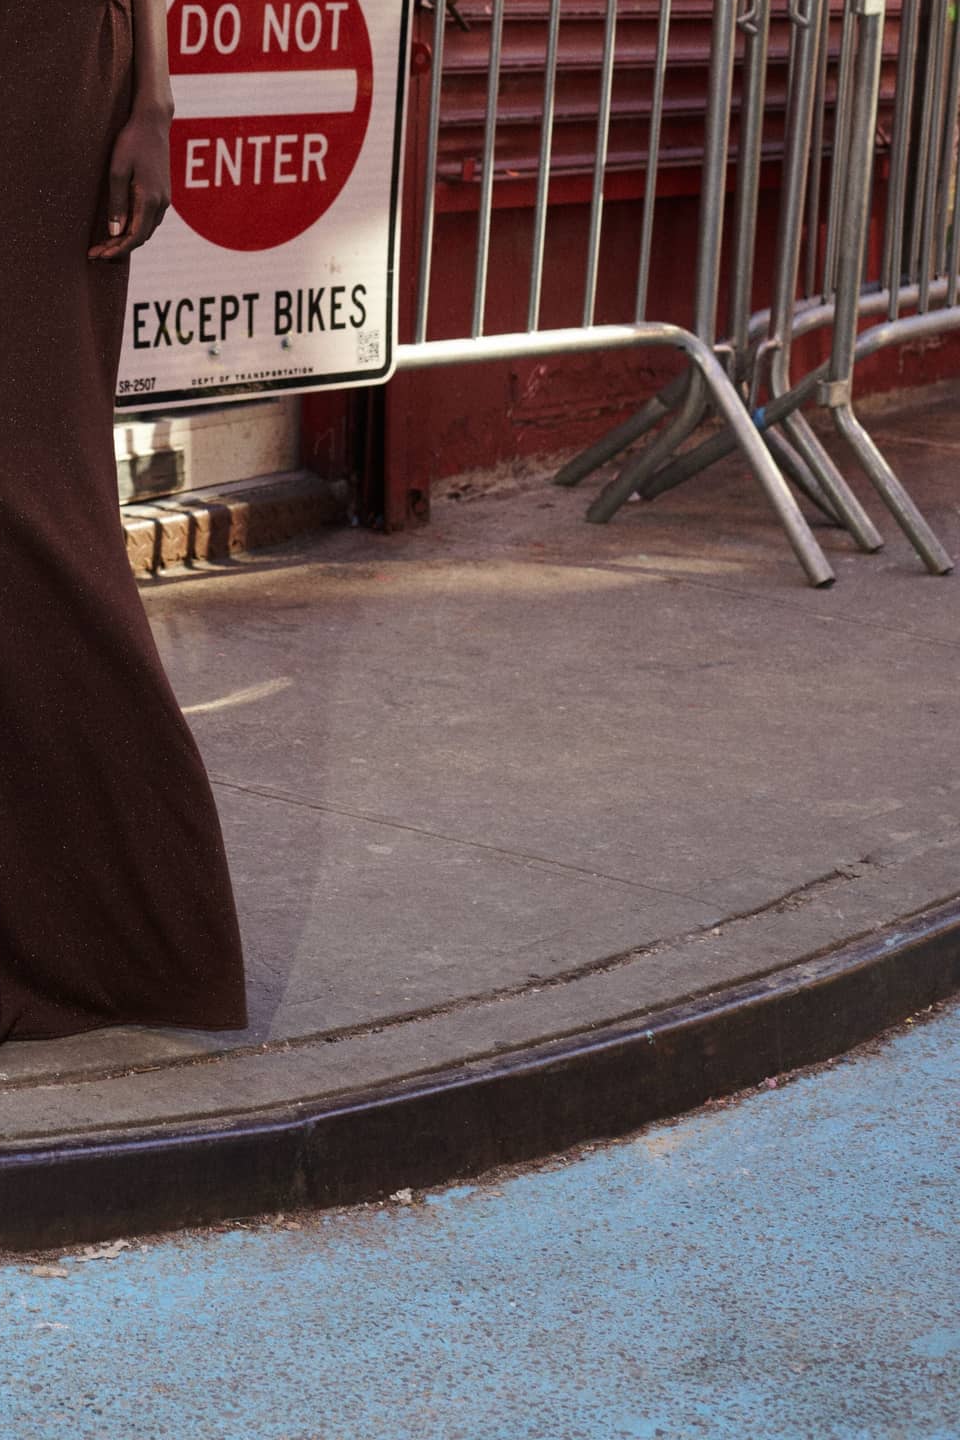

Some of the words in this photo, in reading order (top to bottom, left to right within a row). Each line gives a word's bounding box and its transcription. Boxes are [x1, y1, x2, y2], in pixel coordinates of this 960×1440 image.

[180, 3, 241, 55] DO
[262, 2, 349, 53] NOT
[185, 133, 328, 189] ENTER
[133, 293, 260, 350] EXCEPT
[274, 284, 368, 336] BIKES
[119, 377, 157, 394] SR-2507
[191, 378, 216, 386] DEPT
[219, 375, 231, 383] OF
[235, 367, 314, 381] TRANSPORTATION
